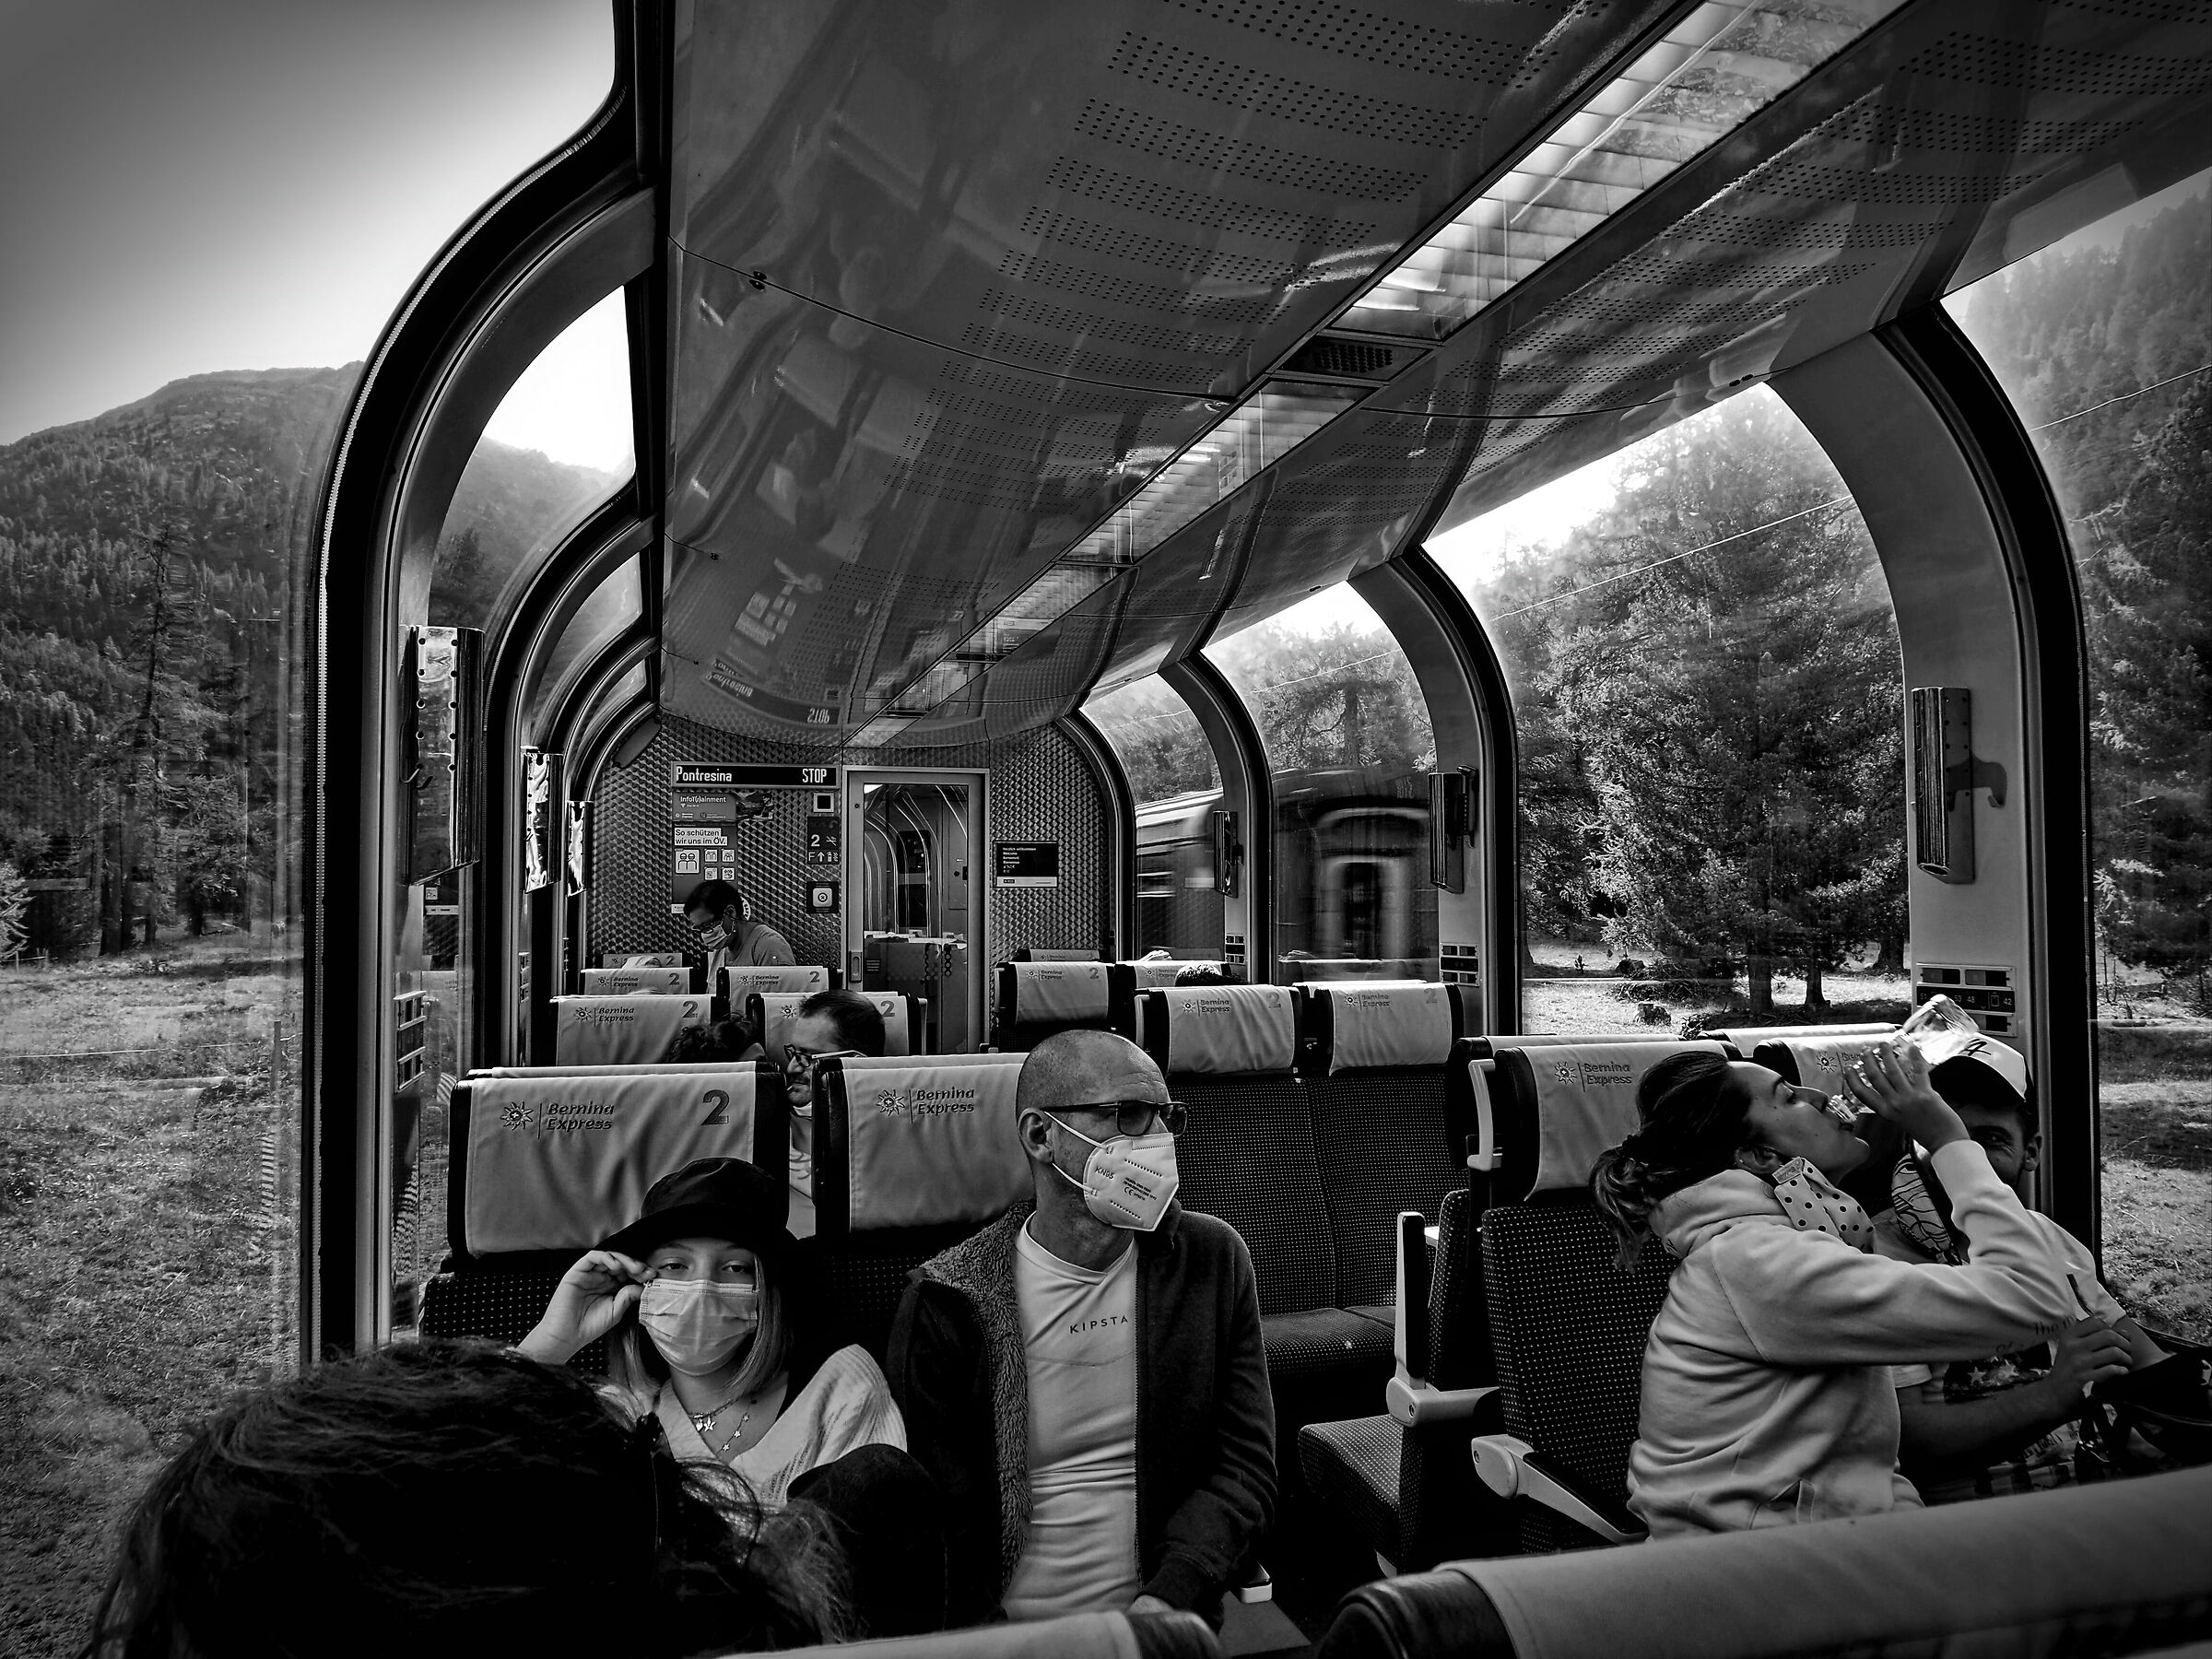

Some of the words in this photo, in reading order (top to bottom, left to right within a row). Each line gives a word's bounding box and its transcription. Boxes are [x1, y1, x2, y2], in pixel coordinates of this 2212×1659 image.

[677, 766, 732, 782] Pontresina
[802, 768, 827, 783] STOP
[811, 834, 820, 847] 2
[808, 852, 815, 861] F
[666, 955, 675, 965] 2
[669, 972, 680, 985] 2
[810, 971, 820, 983] 2
[1089, 967, 1099, 979] 2
[1267, 992, 1282, 1009] 2
[1424, 988, 1437, 1004] 2
[682, 1000, 698, 1018] 2
[880, 1000, 895, 1017] 2
[1584, 1061, 1630, 1072] Bernina
[1587, 1075, 1632, 1086] Express
[917, 1086, 974, 1100] Bernina
[547, 1101, 614, 1115] Bernina
[701, 1089, 729, 1126] 2
[917, 1102, 974, 1116] Express
[546, 1117, 612, 1132] Express
[1095, 1166, 1115, 1179] KN95
[1070, 1315, 1128, 1334] KIPSTA
